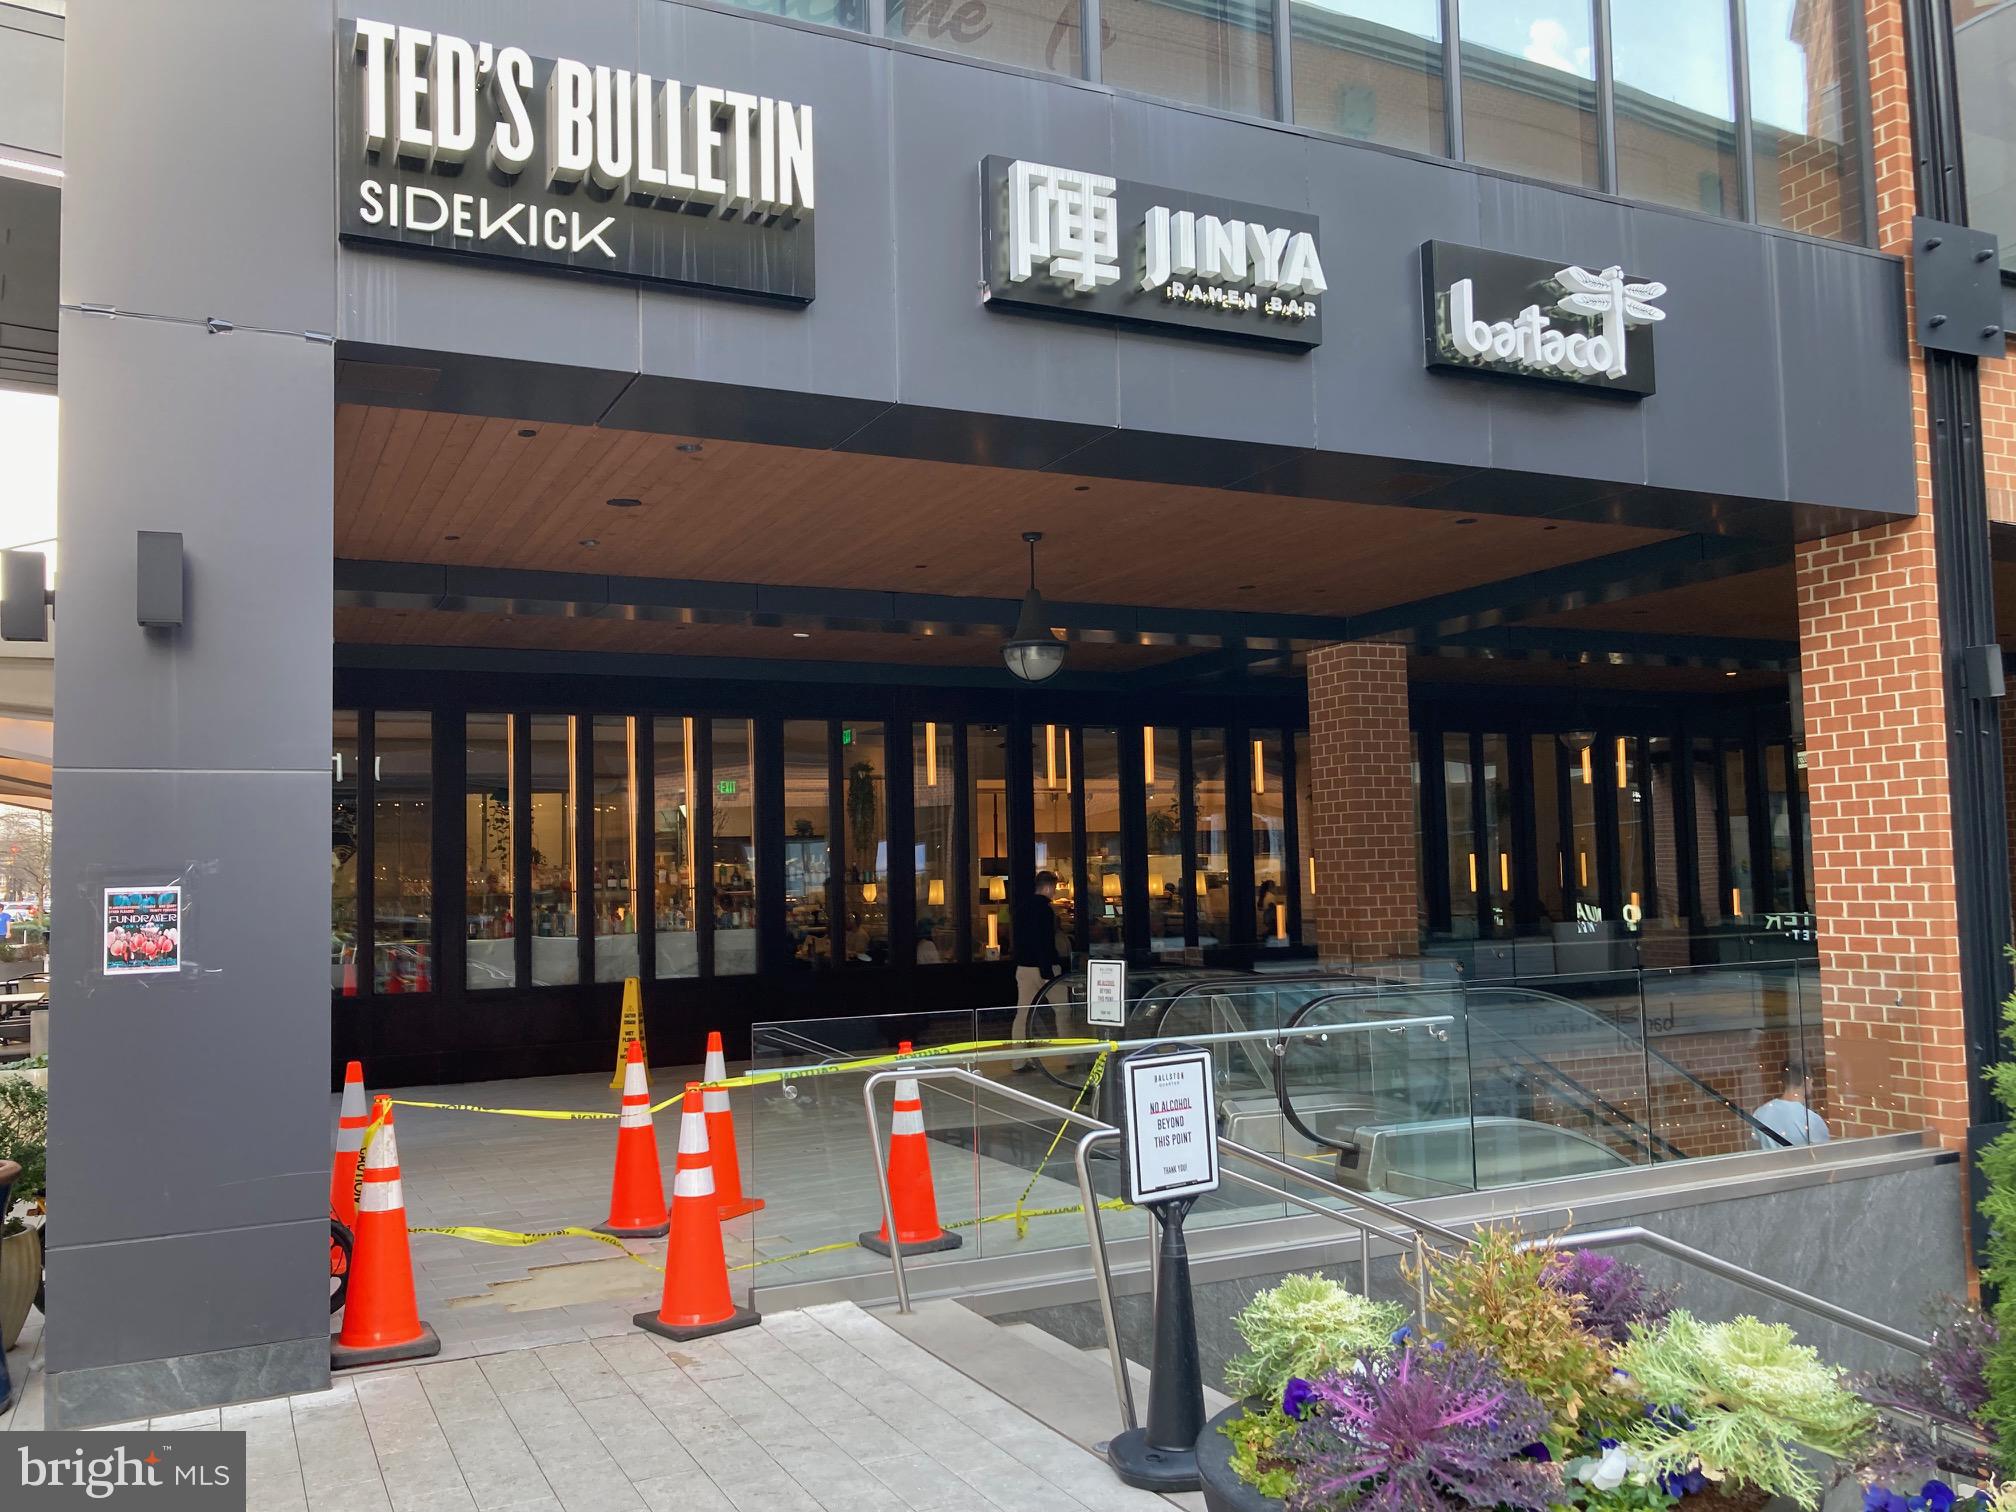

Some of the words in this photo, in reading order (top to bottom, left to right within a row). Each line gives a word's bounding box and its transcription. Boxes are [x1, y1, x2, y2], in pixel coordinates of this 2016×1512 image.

[356, 17, 534, 163] TED'S
[557, 57, 814, 210] BULLETIN
[358, 179, 616, 258] SIDEKICK
[1140, 205, 1328, 295] JINYA
[1167, 281, 1257, 309] RAMEN
[1266, 296, 1316, 319] BAR
[1451, 278, 1616, 376] bartaco
[720, 781, 736, 794] EXIT
[1150, 1102, 1159, 1114] NO
[1162, 1098, 1192, 1112] ALCOHOL
[1157, 1116, 1184, 1130] BEYOND
[1154, 1135, 1170, 1148] THIS
[1172, 1131, 1192, 1146] POINT
[1163, 1165, 1177, 1175] THANK
